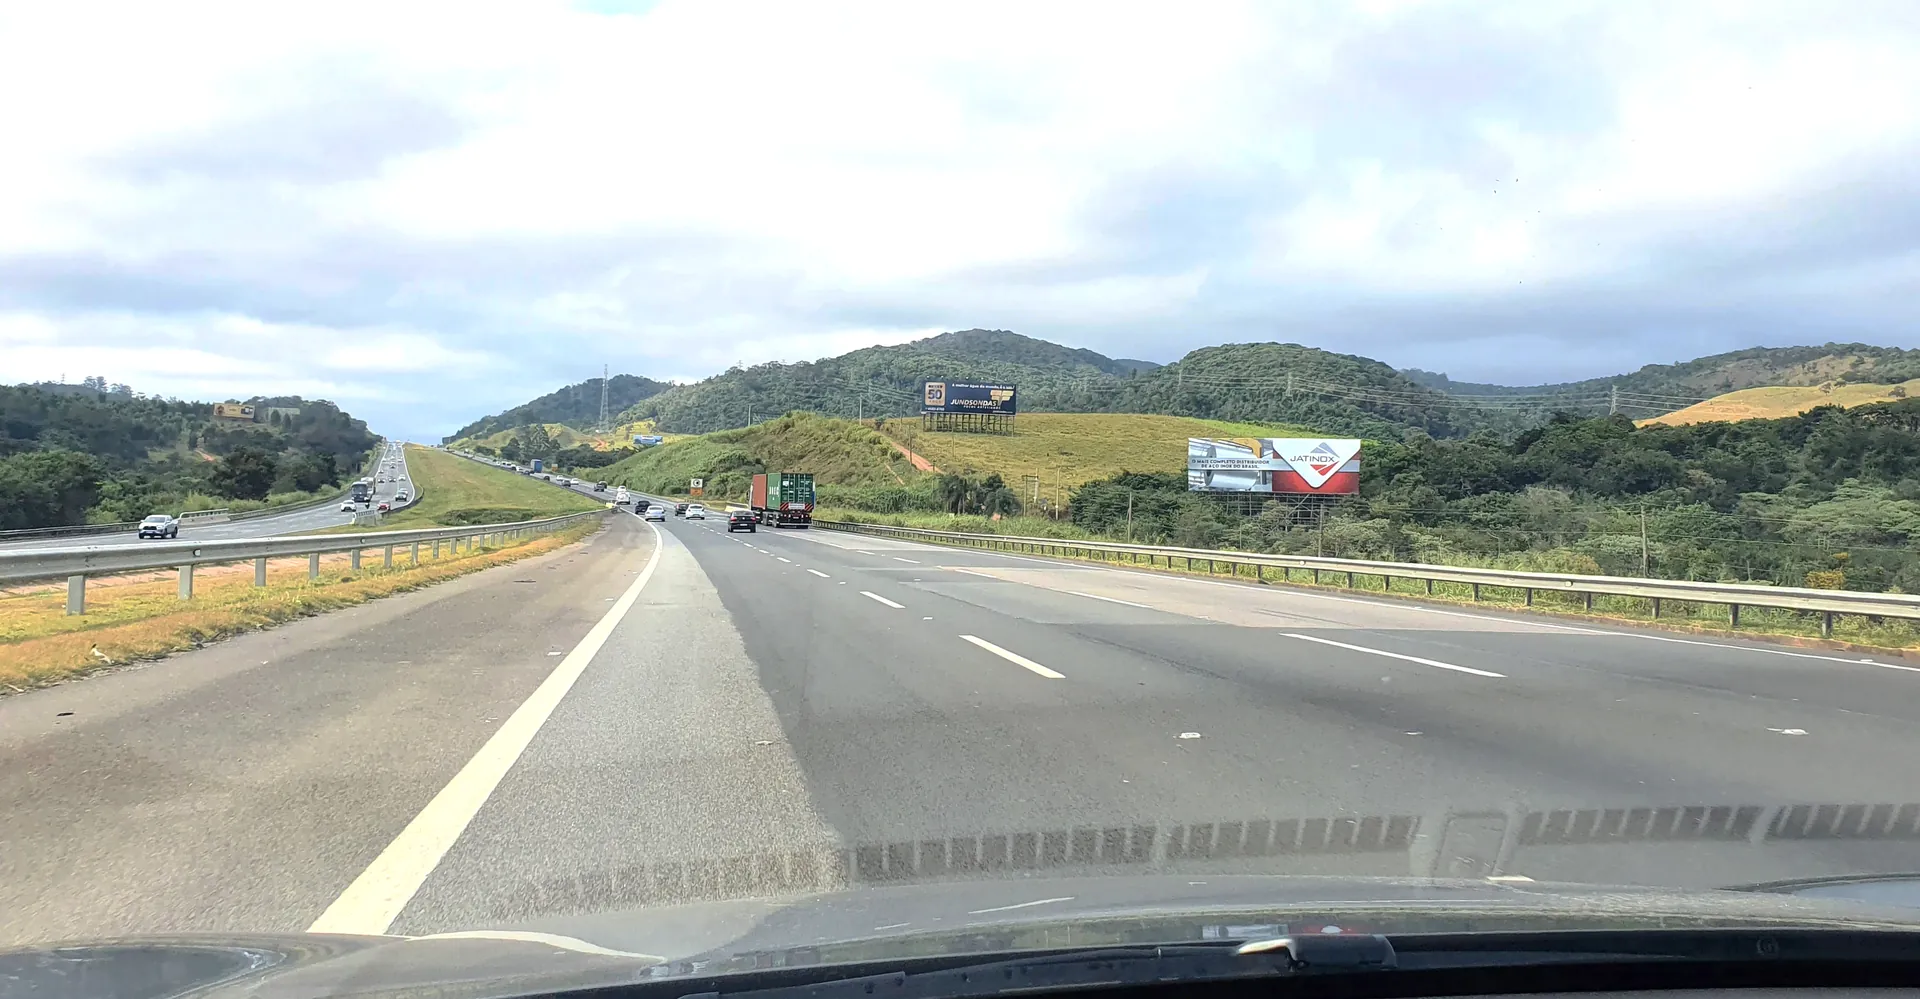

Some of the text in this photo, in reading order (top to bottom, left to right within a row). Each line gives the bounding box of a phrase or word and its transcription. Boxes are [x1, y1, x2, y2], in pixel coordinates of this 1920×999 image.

[928, 389, 942, 400] 50
[950, 398, 997, 407] JUNDSONDAS
[1290, 455, 1335, 463] JATINOX
